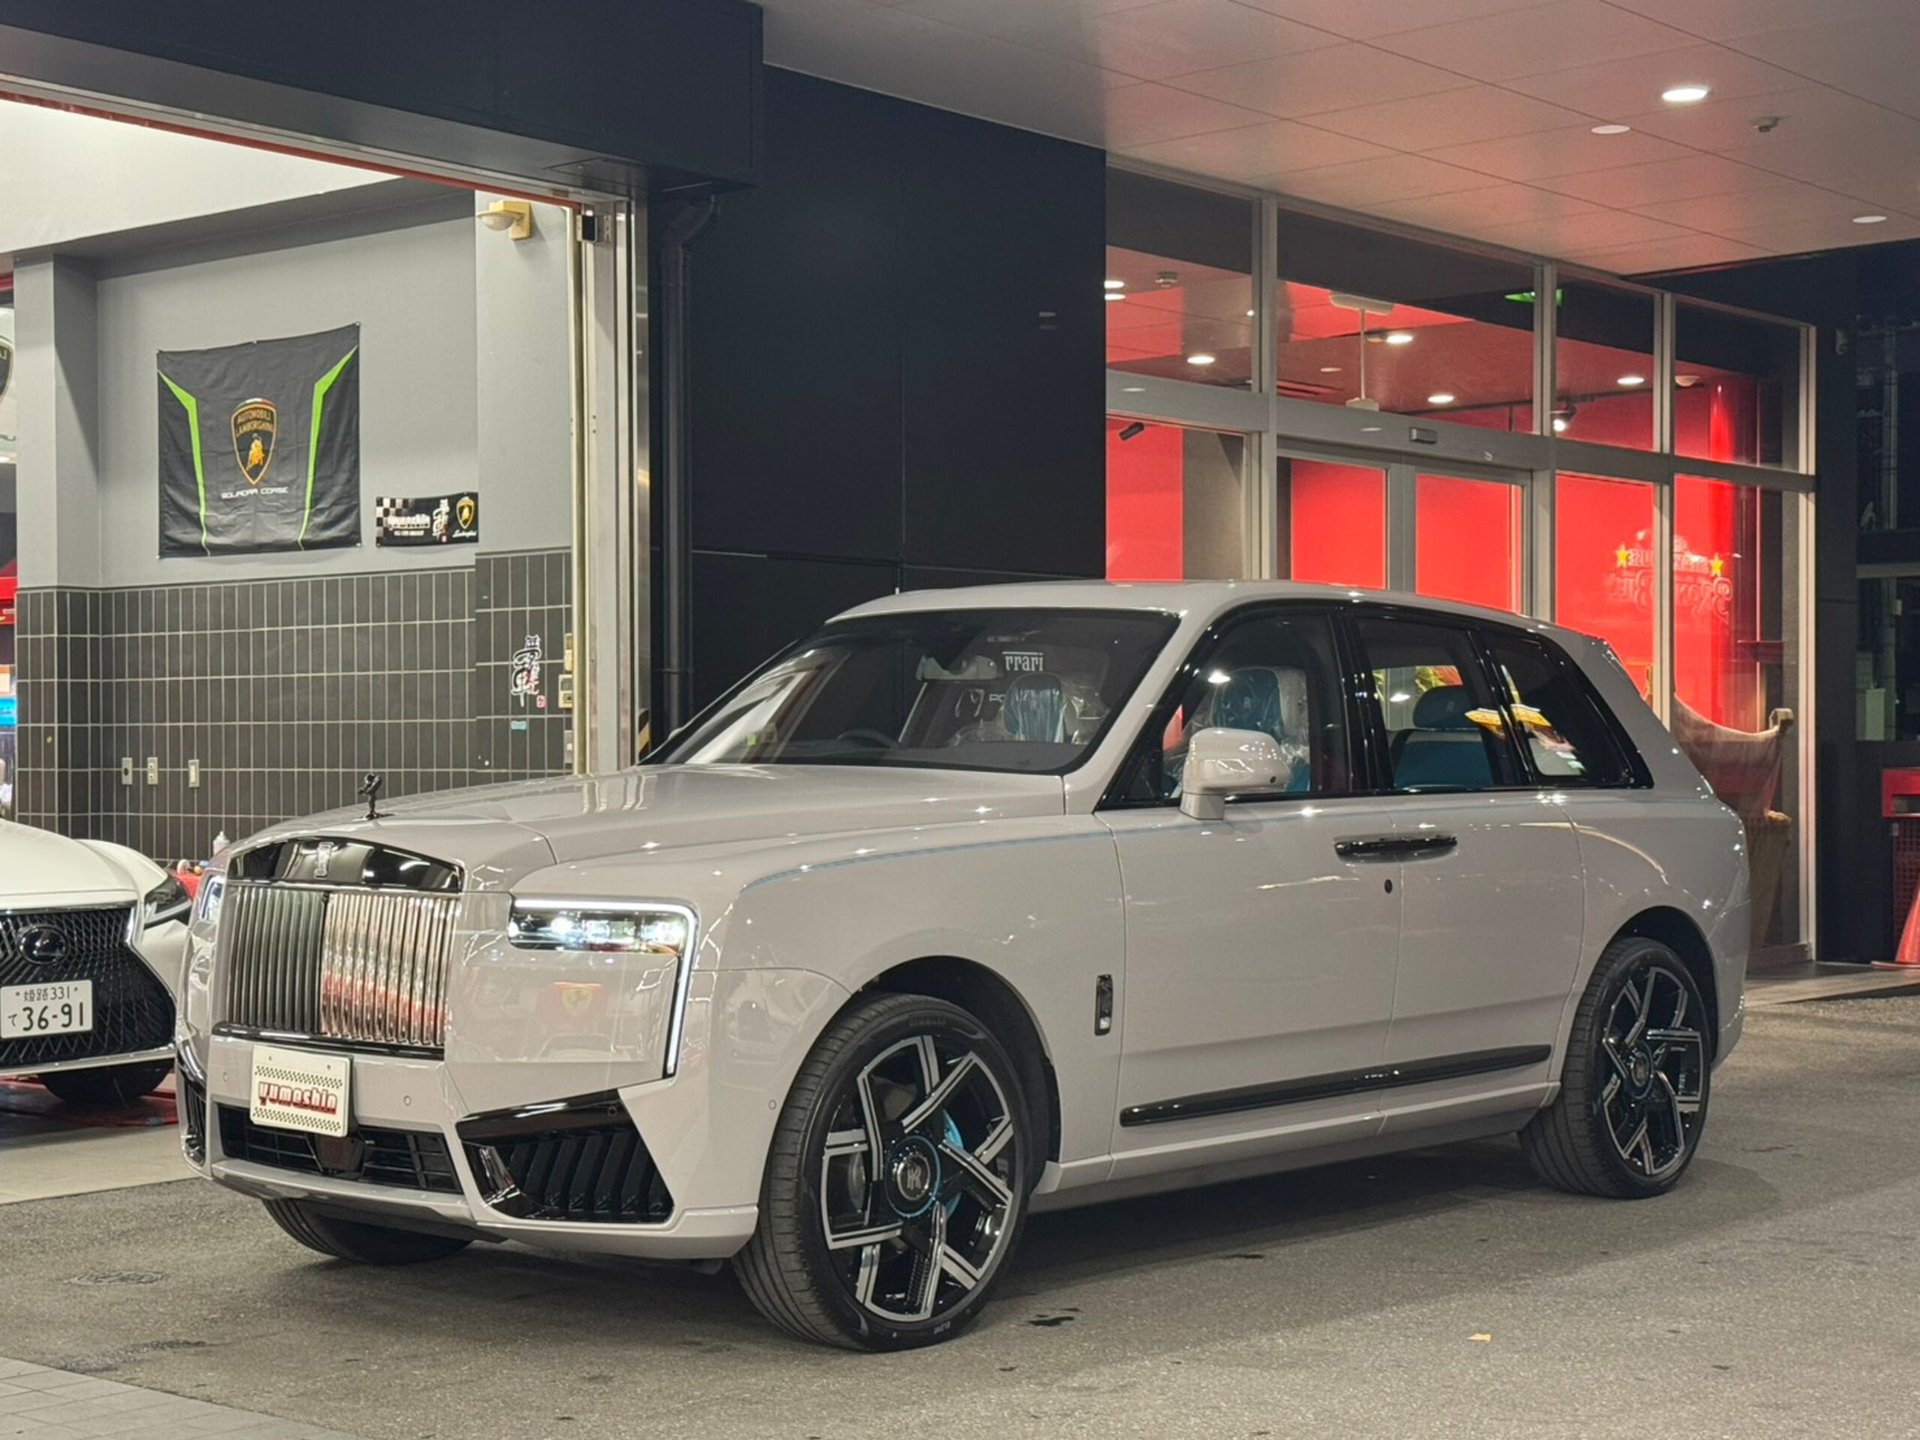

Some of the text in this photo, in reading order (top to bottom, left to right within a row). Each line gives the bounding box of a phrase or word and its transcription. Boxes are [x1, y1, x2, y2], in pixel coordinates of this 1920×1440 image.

[50, 985, 70, 1001] 331
[8, 1002, 84, 1031] て 36-91
